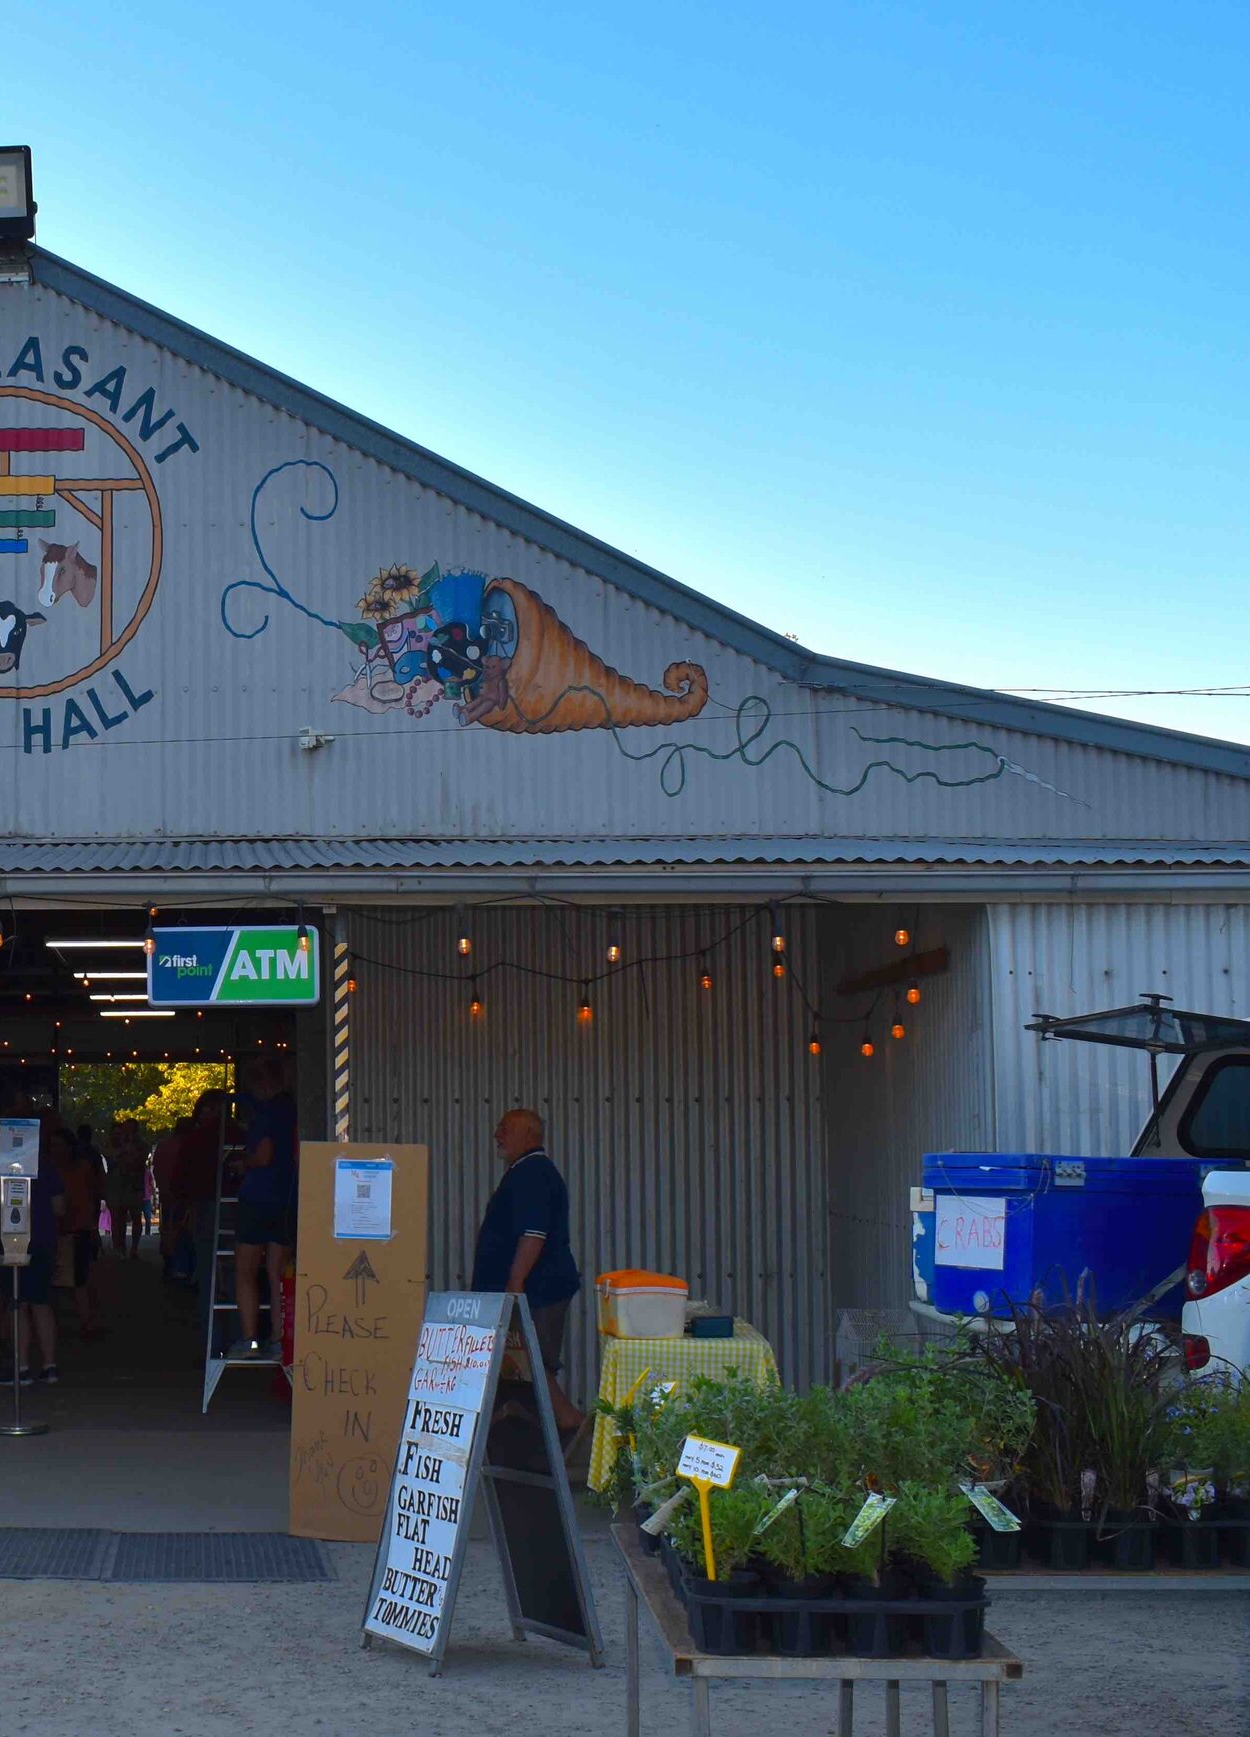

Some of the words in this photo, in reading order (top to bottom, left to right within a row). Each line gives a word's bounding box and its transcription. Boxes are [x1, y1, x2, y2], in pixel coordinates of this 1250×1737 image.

[23, 669, 155, 754] HALL
[172, 954, 198, 967] first
[230, 950, 309, 980] ATM
[177, 965, 212, 979] point
[937, 1216, 1005, 1250] CRABS
[306, 1284, 390, 1339] PLEASE
[447, 1299, 481, 1319] OPEN
[418, 1325, 467, 1360] BUTTER
[303, 1351, 376, 1396] CHECK
[344, 1410, 372, 1442] IN
[410, 1400, 464, 1438] FRESH
[402, 1440, 443, 1484] FISH
[398, 1485, 461, 1524] GARFISH
[396, 1512, 430, 1545] FLAT
[411, 1547, 451, 1581] HEAD
[382, 1567, 438, 1607] BUTTER
[373, 1597, 440, 1639] TOMMIES
